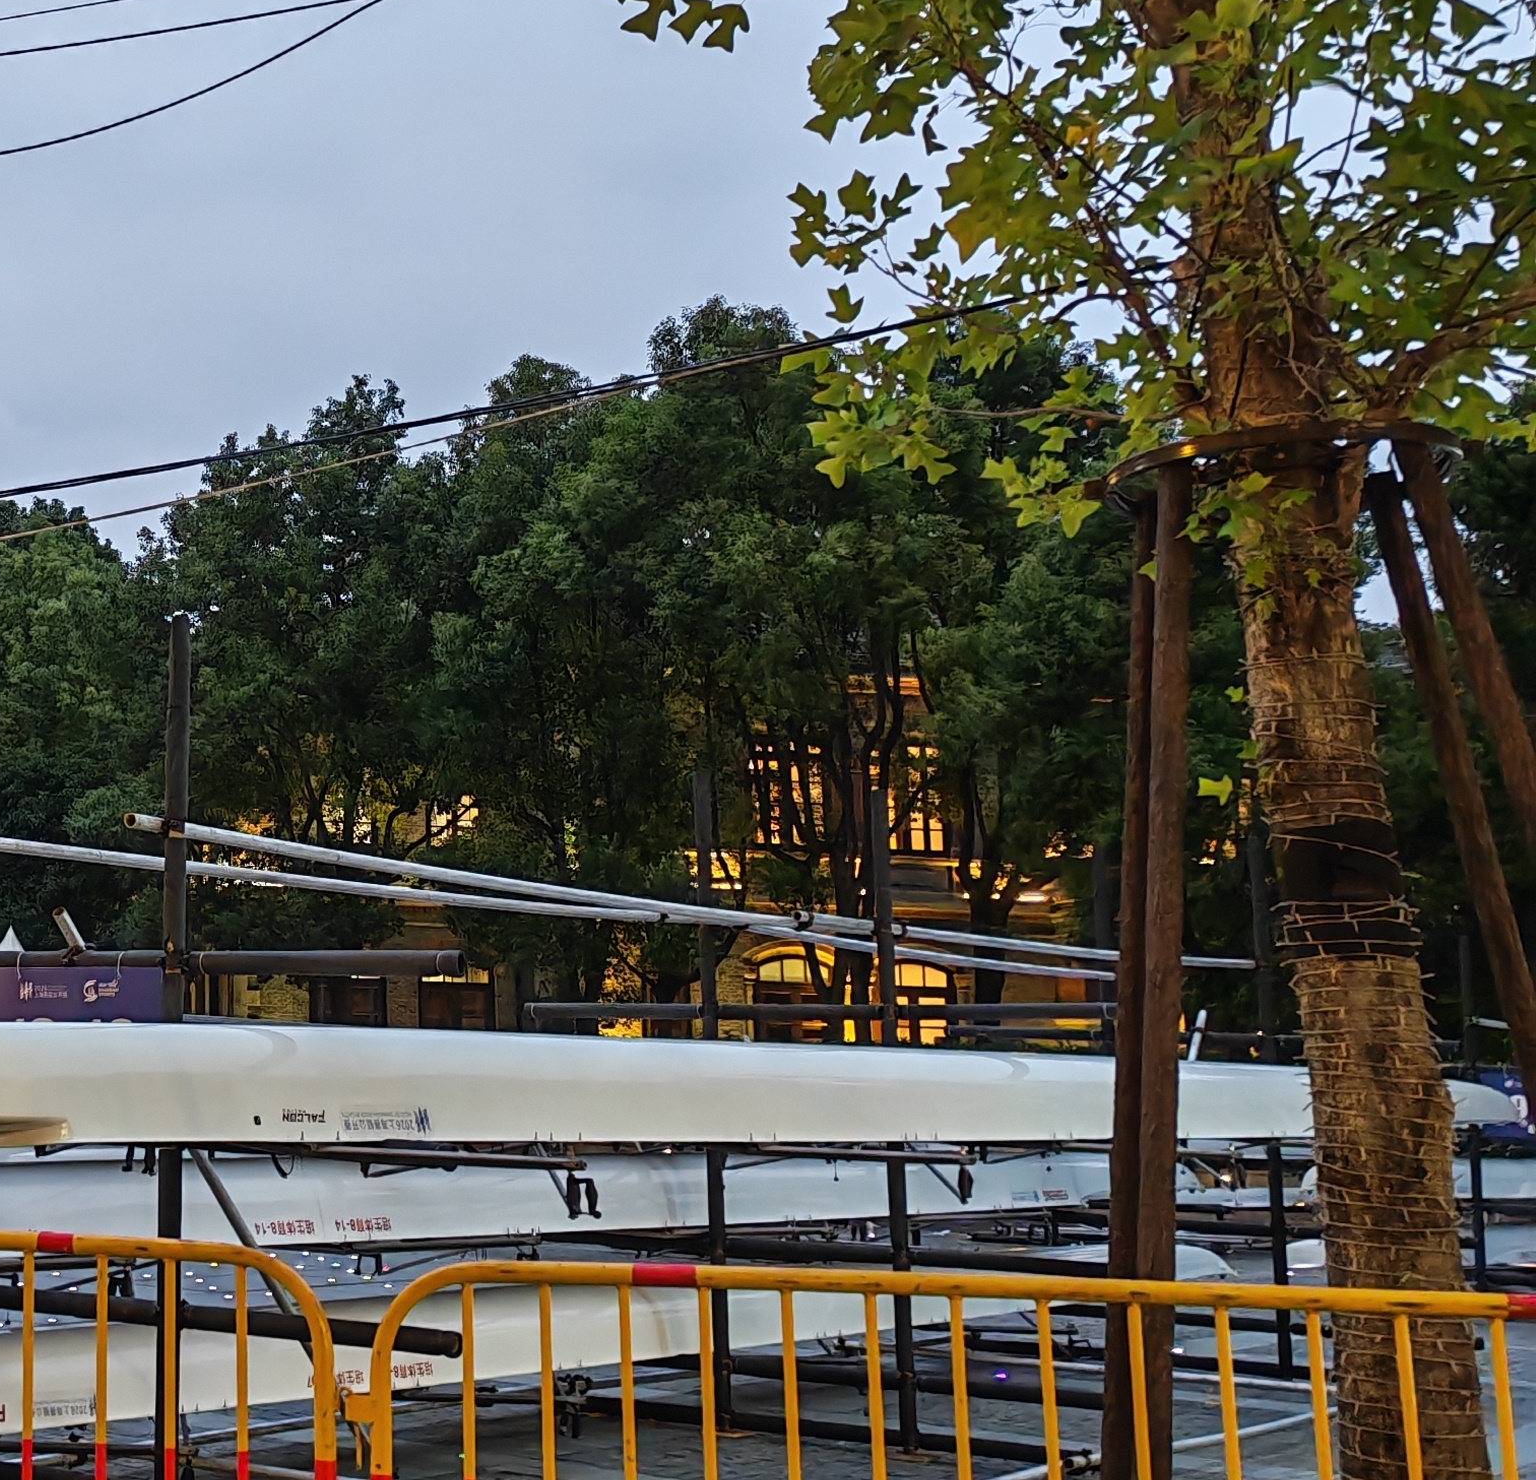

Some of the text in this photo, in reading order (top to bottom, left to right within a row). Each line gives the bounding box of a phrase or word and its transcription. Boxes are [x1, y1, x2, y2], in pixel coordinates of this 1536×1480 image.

[281, 1109, 327, 1124] FALCON
[254, 1216, 392, 1237] 培生体育8-14 培生体育8-14
